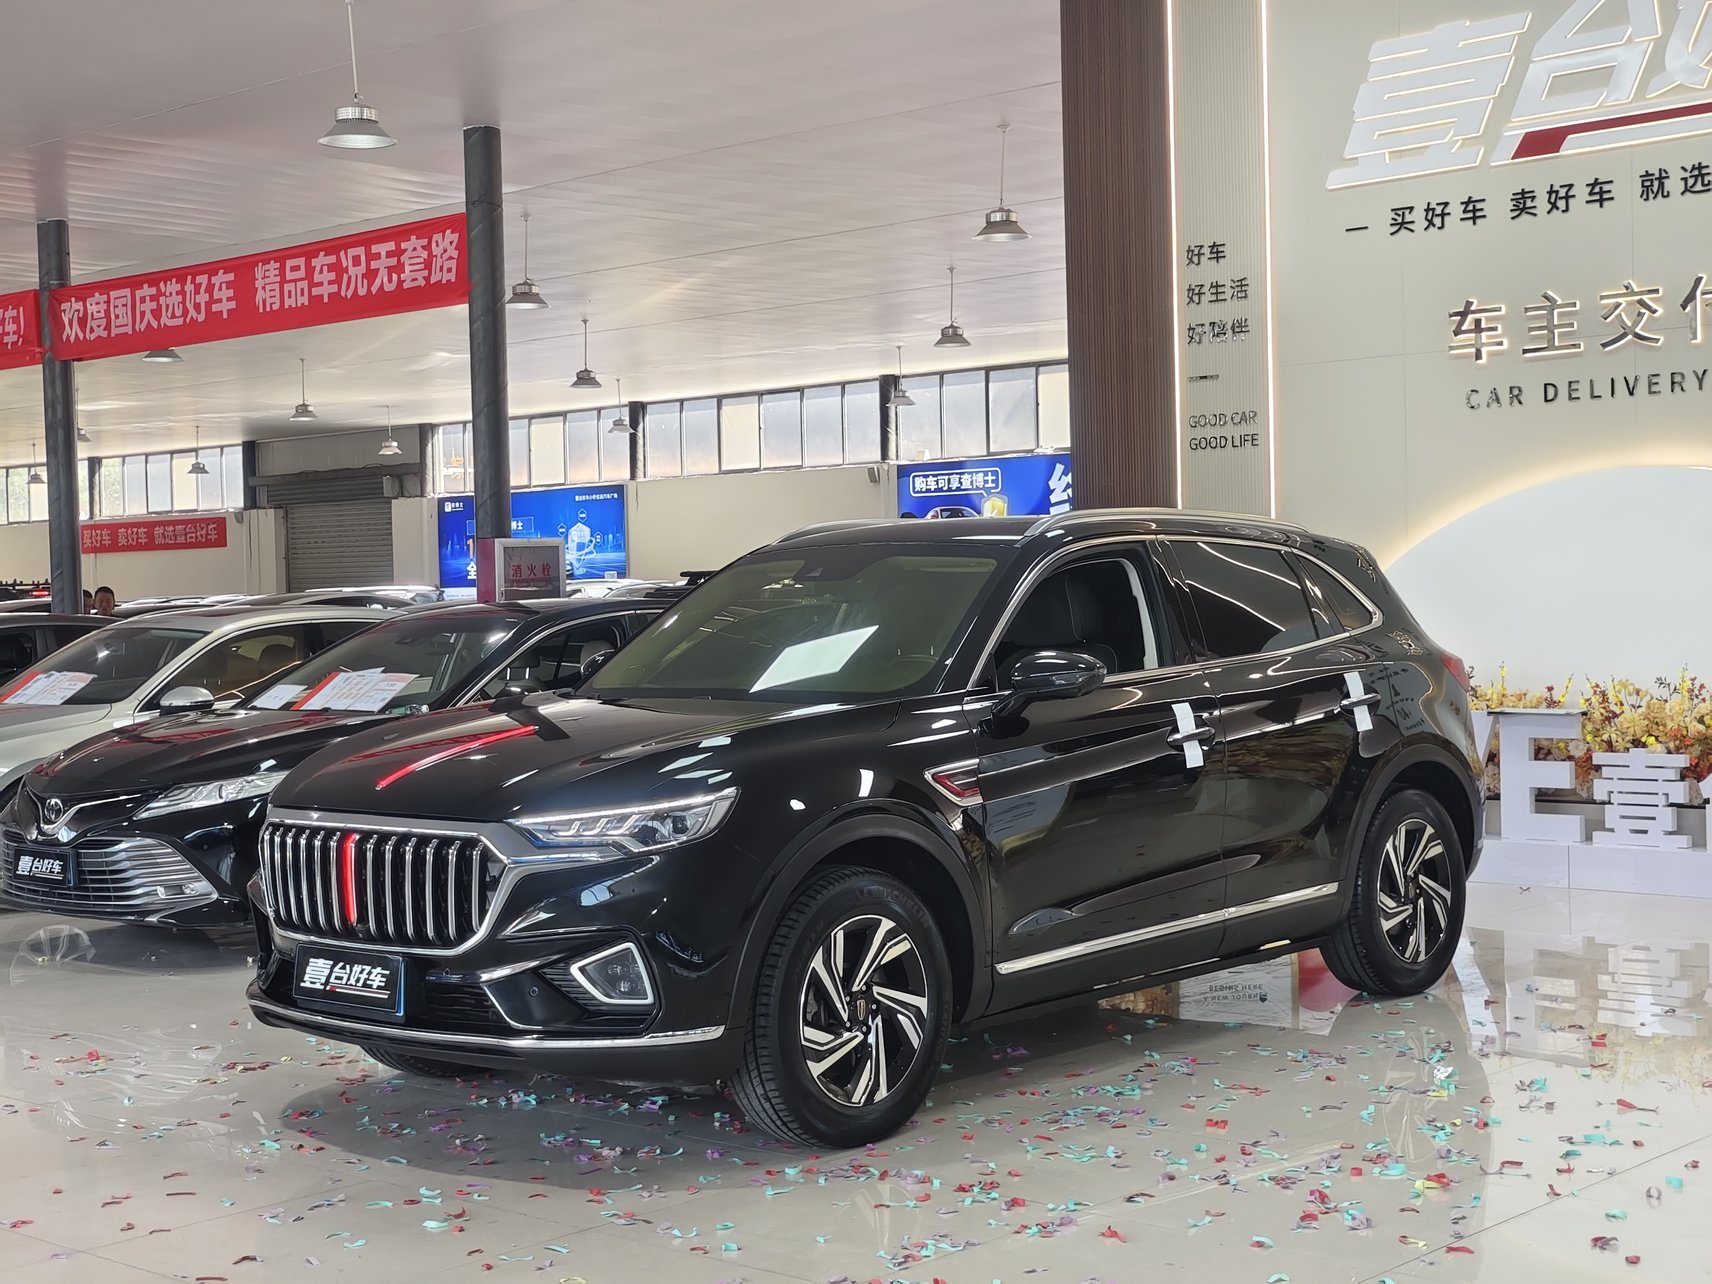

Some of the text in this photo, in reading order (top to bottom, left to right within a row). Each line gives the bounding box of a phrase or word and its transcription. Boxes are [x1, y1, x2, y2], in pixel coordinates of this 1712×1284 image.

[1388, 161, 1712, 237] 买好车 卖好车 就选
[1185, 240, 1227, 266] 好车
[60, 228, 460, 345] 欢度国庆选好车 精品车况无套路
[1185, 277, 1250, 306] 好生活
[1186, 315, 1250, 345] 好陪伴
[1466, 368, 1709, 410] CAR DELIVERY
[1188, 410, 1258, 428] GOOD CAR
[1189, 433, 1259, 451] GOOD LIFE
[914, 473, 997, 492] 购车可享查博士
[83, 522, 218, 548] 买好车 卖好车 就选壹台好车
[512, 563, 552, 578] 消火栓
[17, 855, 64, 879] 壹台好车
[300, 957, 391, 998] 壹台好车
